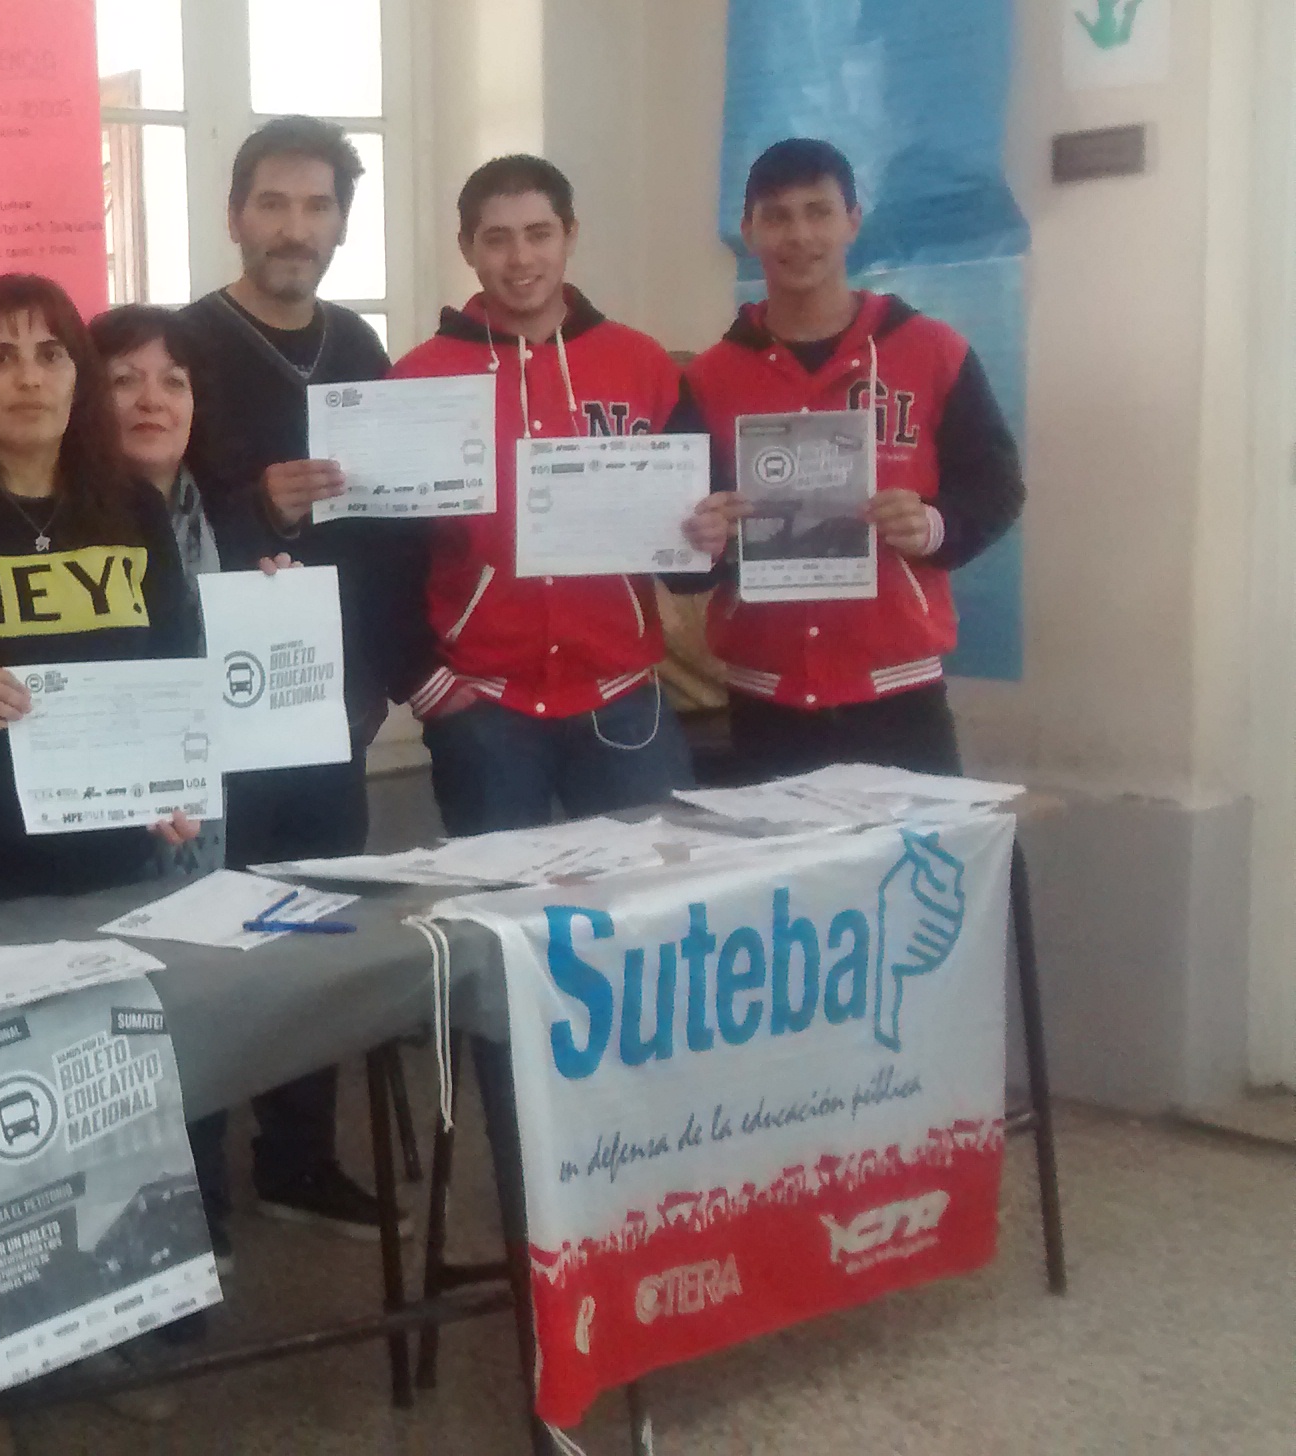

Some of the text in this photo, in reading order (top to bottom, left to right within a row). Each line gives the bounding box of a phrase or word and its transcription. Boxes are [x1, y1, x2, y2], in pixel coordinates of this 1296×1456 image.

[269, 662, 334, 690] EDUCATIVO
[270, 646, 315, 671] BOLETO
[270, 683, 326, 710] NACIONAL
[544, 887, 870, 1080] Suteba
[117, 1012, 164, 1030] SUMATE!
[59, 1039, 128, 1091] BOLETO
[63, 1053, 160, 1119] EDUCATIVO
[67, 1086, 153, 1145] NACIONAL
[587, 1131, 669, 1183] defensa
[678, 1112, 703, 1151] de
[711, 1104, 732, 1141] la
[741, 1088, 845, 1134] educación
